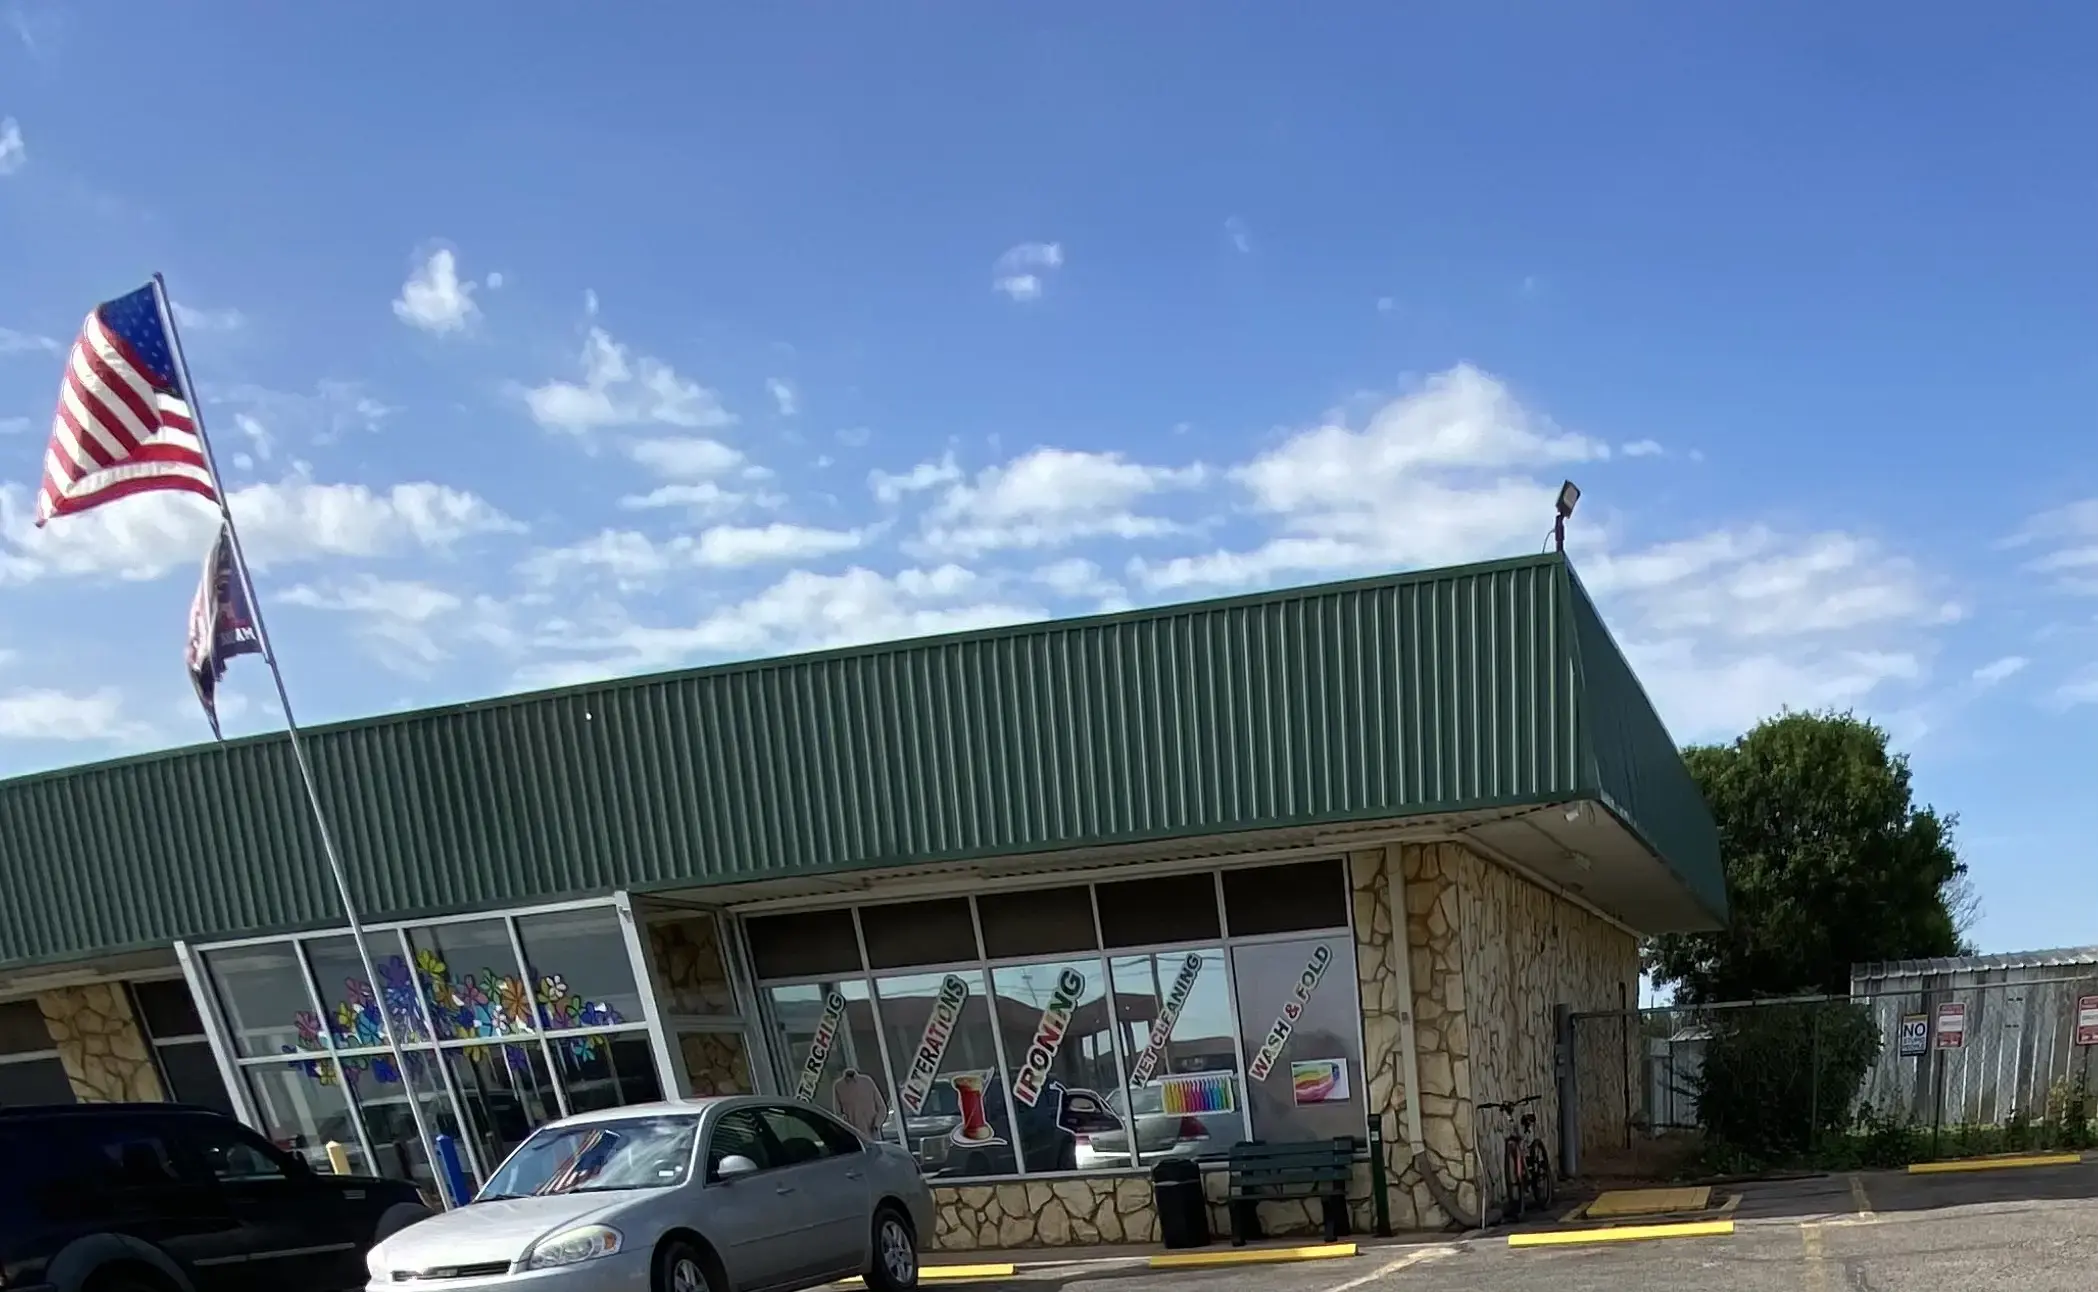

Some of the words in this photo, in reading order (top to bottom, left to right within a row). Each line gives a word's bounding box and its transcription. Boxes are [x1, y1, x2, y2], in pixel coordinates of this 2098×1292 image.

[903, 977, 964, 1111] ALTERATIONS
[1015, 969, 1082, 1104] IRONING
[1130, 1046, 1157, 1087] WET
[1150, 953, 1199, 1047] CLEANING
[1251, 1019, 1290, 1080] WASH
[1284, 1003, 1300, 1020] &
[1297, 945, 1329, 1000] FOLD
[1903, 1022, 1926, 1037] NO
